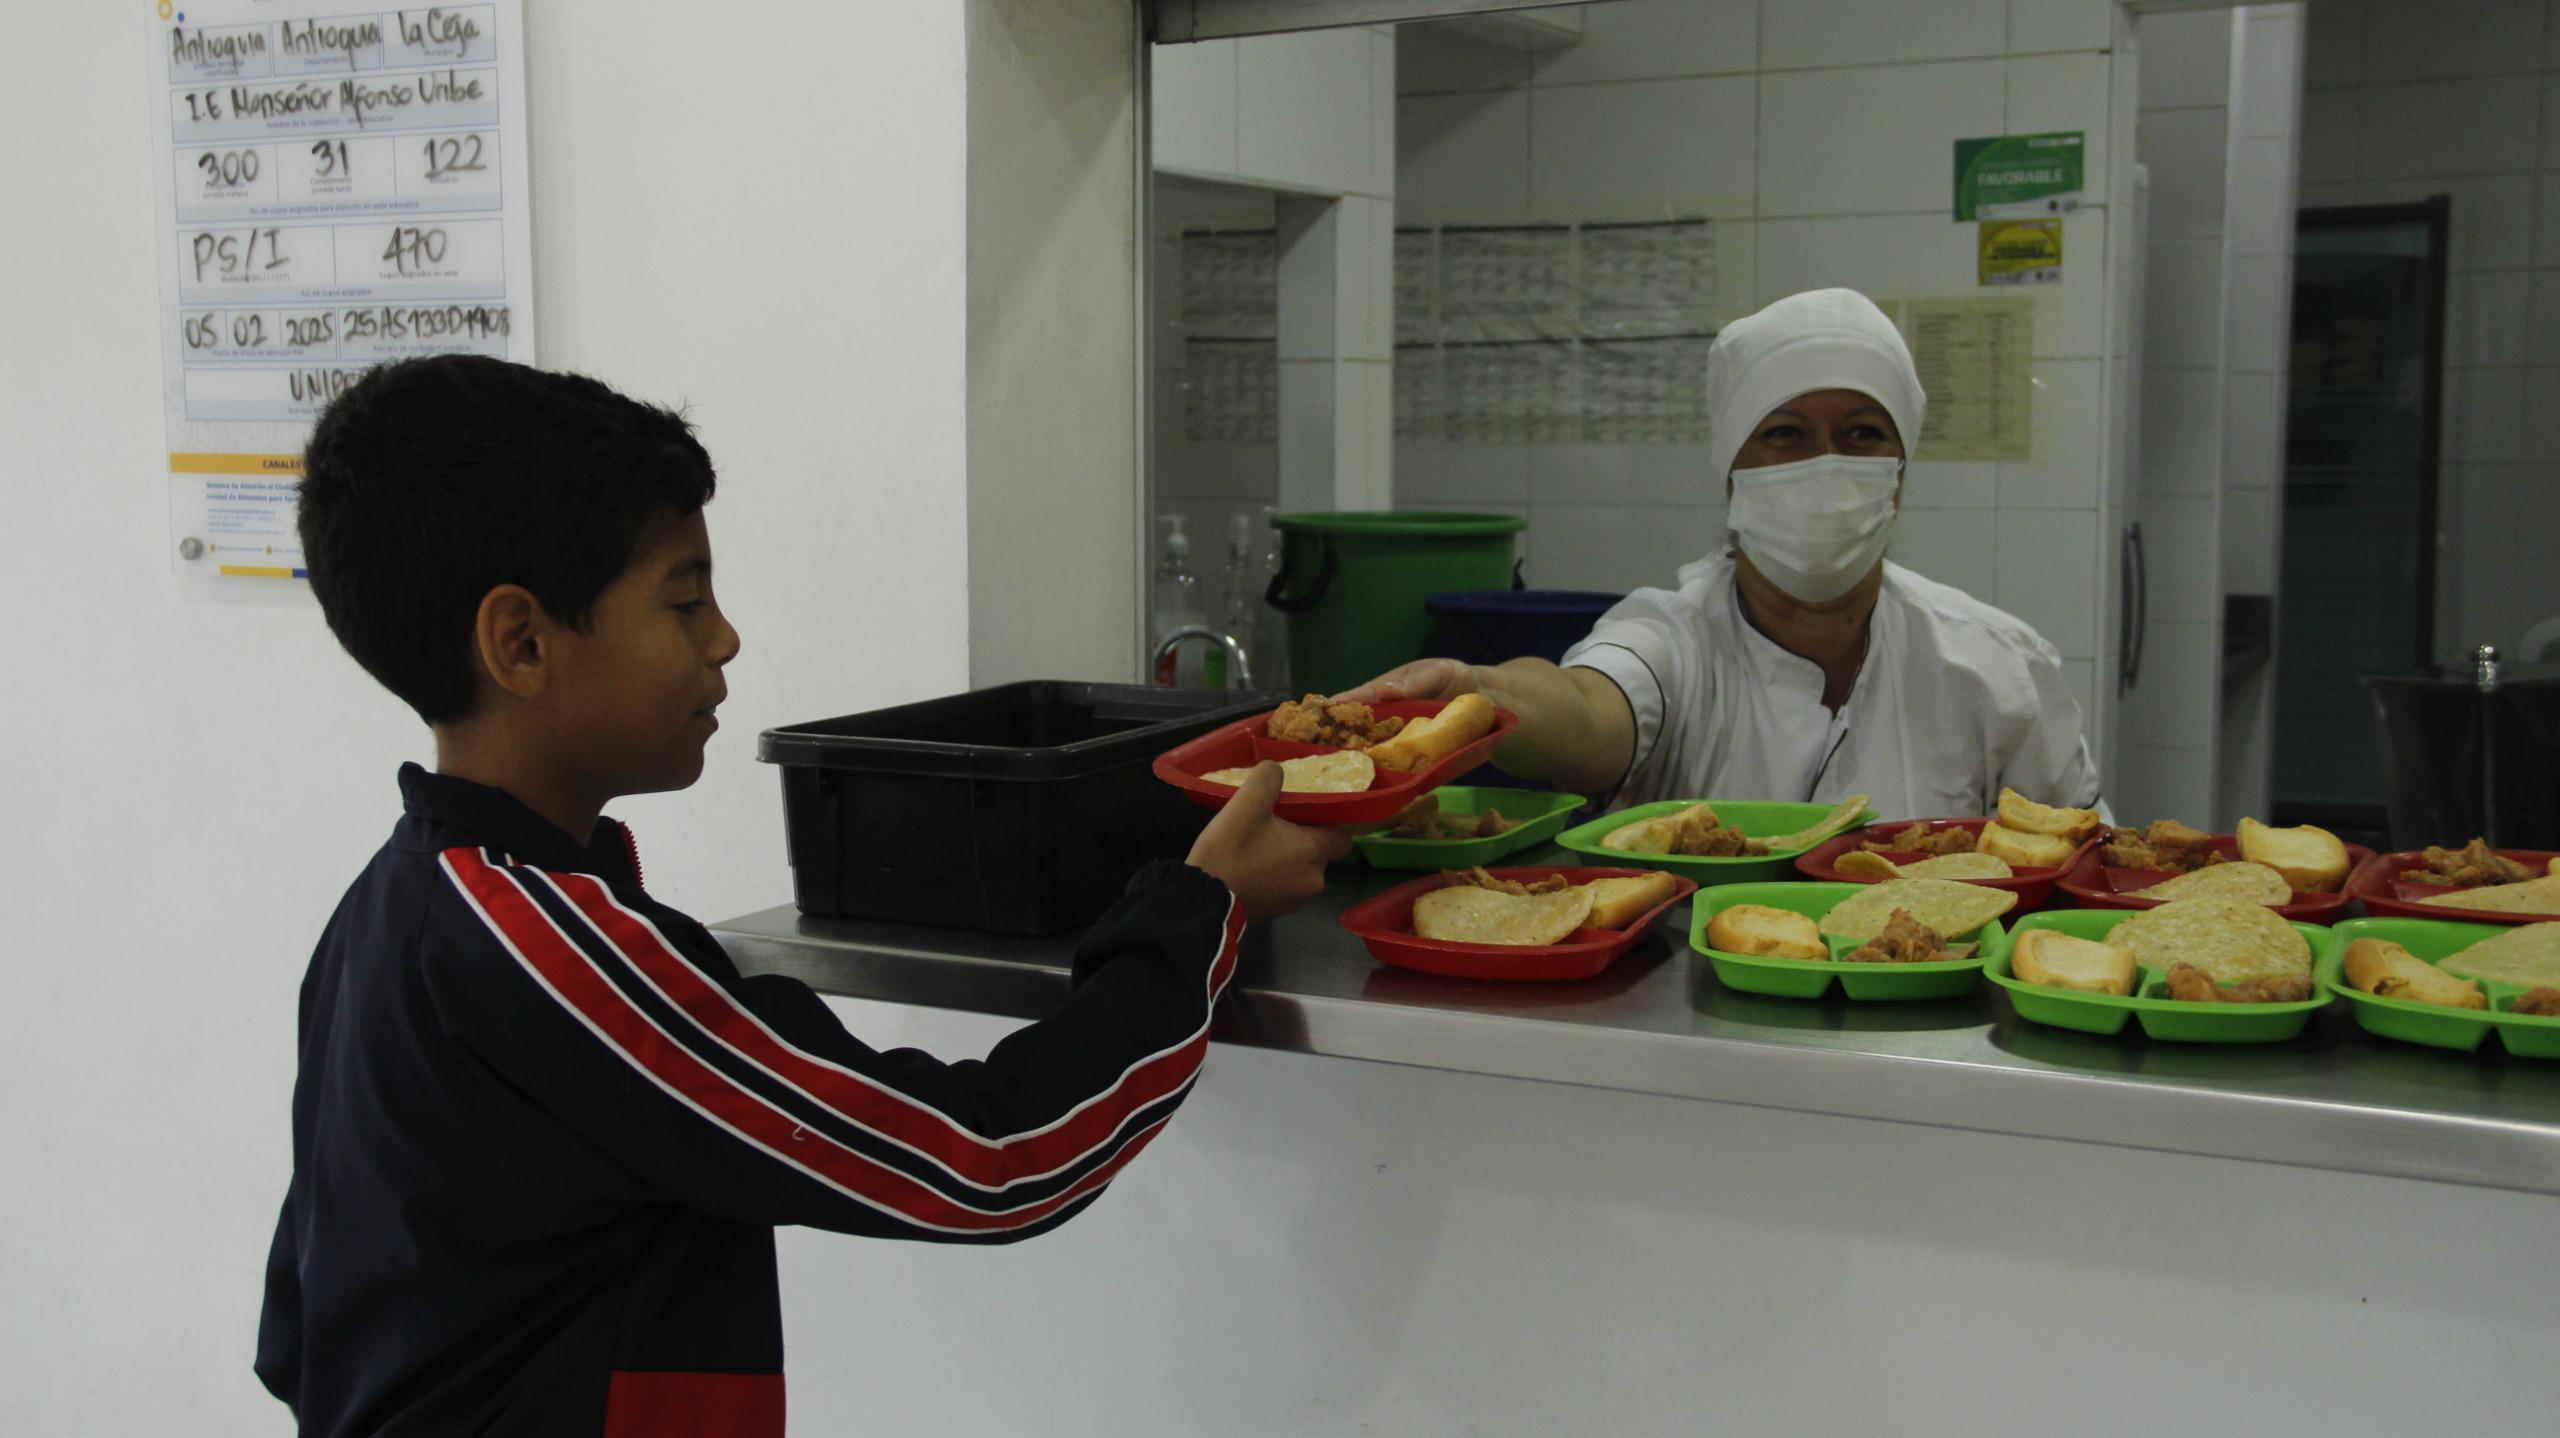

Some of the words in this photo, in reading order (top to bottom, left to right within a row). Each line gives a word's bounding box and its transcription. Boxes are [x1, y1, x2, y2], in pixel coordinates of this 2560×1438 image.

[173, 27, 266, 73] Antioquia
[282, 18, 381, 72] Antioquia
[419, 69, 483, 104] Uribe
[198, 149, 259, 187] 300
[312, 139, 348, 178] 31
[424, 134, 487, 179] 122
[1978, 168, 2065, 187] FAVORABLE
[382, 226, 447, 275] 470
[185, 312, 217, 349] 05
[234, 314, 267, 347] 02
[286, 311, 334, 347] 2025
